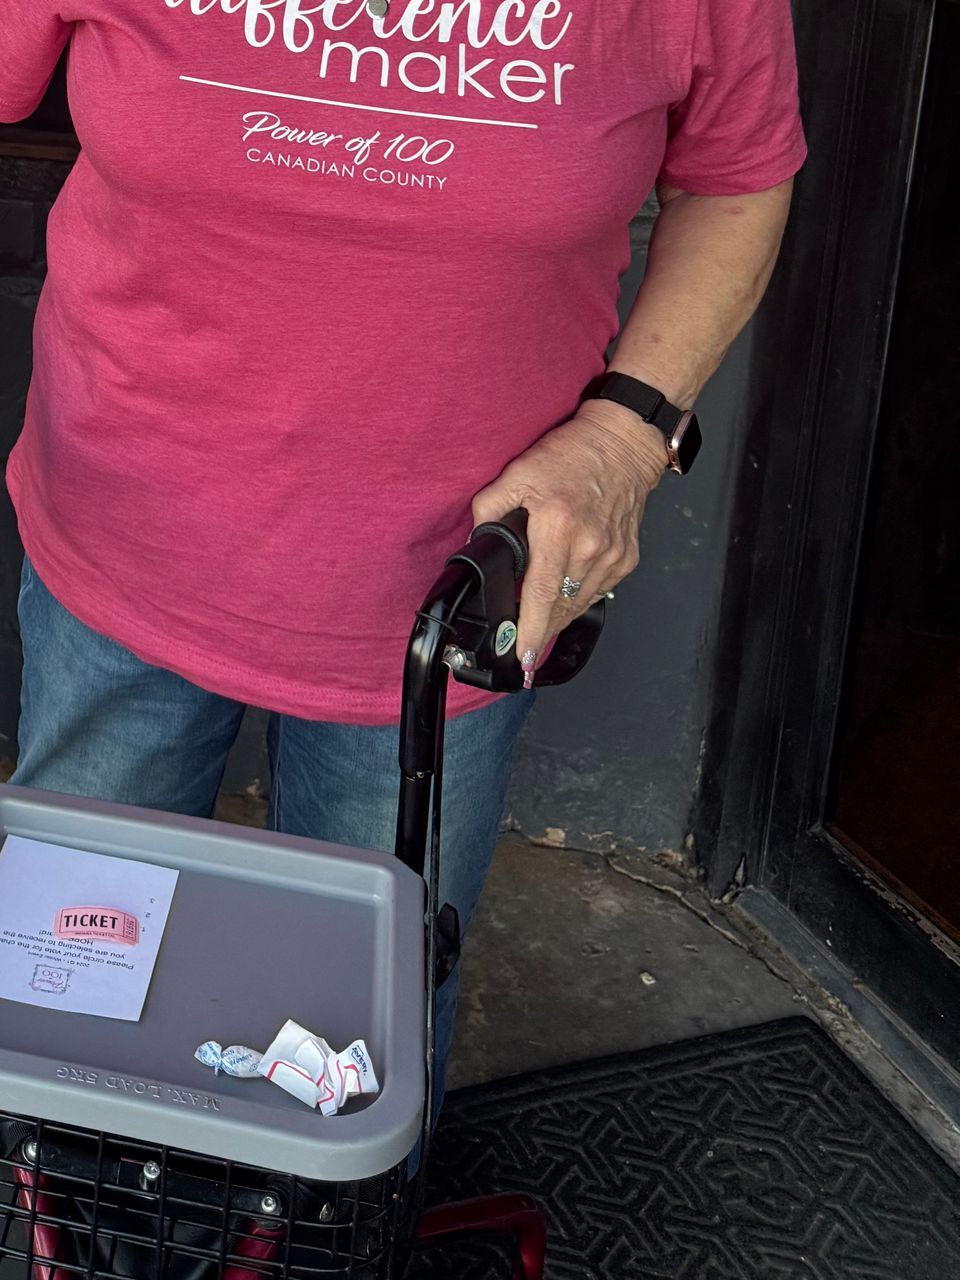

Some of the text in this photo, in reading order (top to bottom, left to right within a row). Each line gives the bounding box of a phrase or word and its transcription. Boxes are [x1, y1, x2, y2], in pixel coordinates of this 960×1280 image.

[319, 39, 574, 105] maker
[243, 111, 455, 166] Power of 100
[246, 147, 447, 190] CANADIAN COUNTY
[64, 914, 119, 929] TICKET
[3, 930, 16, 938] the
[17, 932, 47, 944] receive
[17, 941, 30, 949] the
[32, 944, 43, 952] for
[57, 940, 93, 953] selecting
[44, 947, 62, 955] vote
[63, 951, 82, 959] your
[110, 952, 126, 960] you
[83, 954, 105, 964] circle
[106, 960, 134, 970] Please
[42, 970, 62, 979] 100
[56, 1066, 99, 1085] 5KG
[104, 1076, 162, 1099] LOAD
